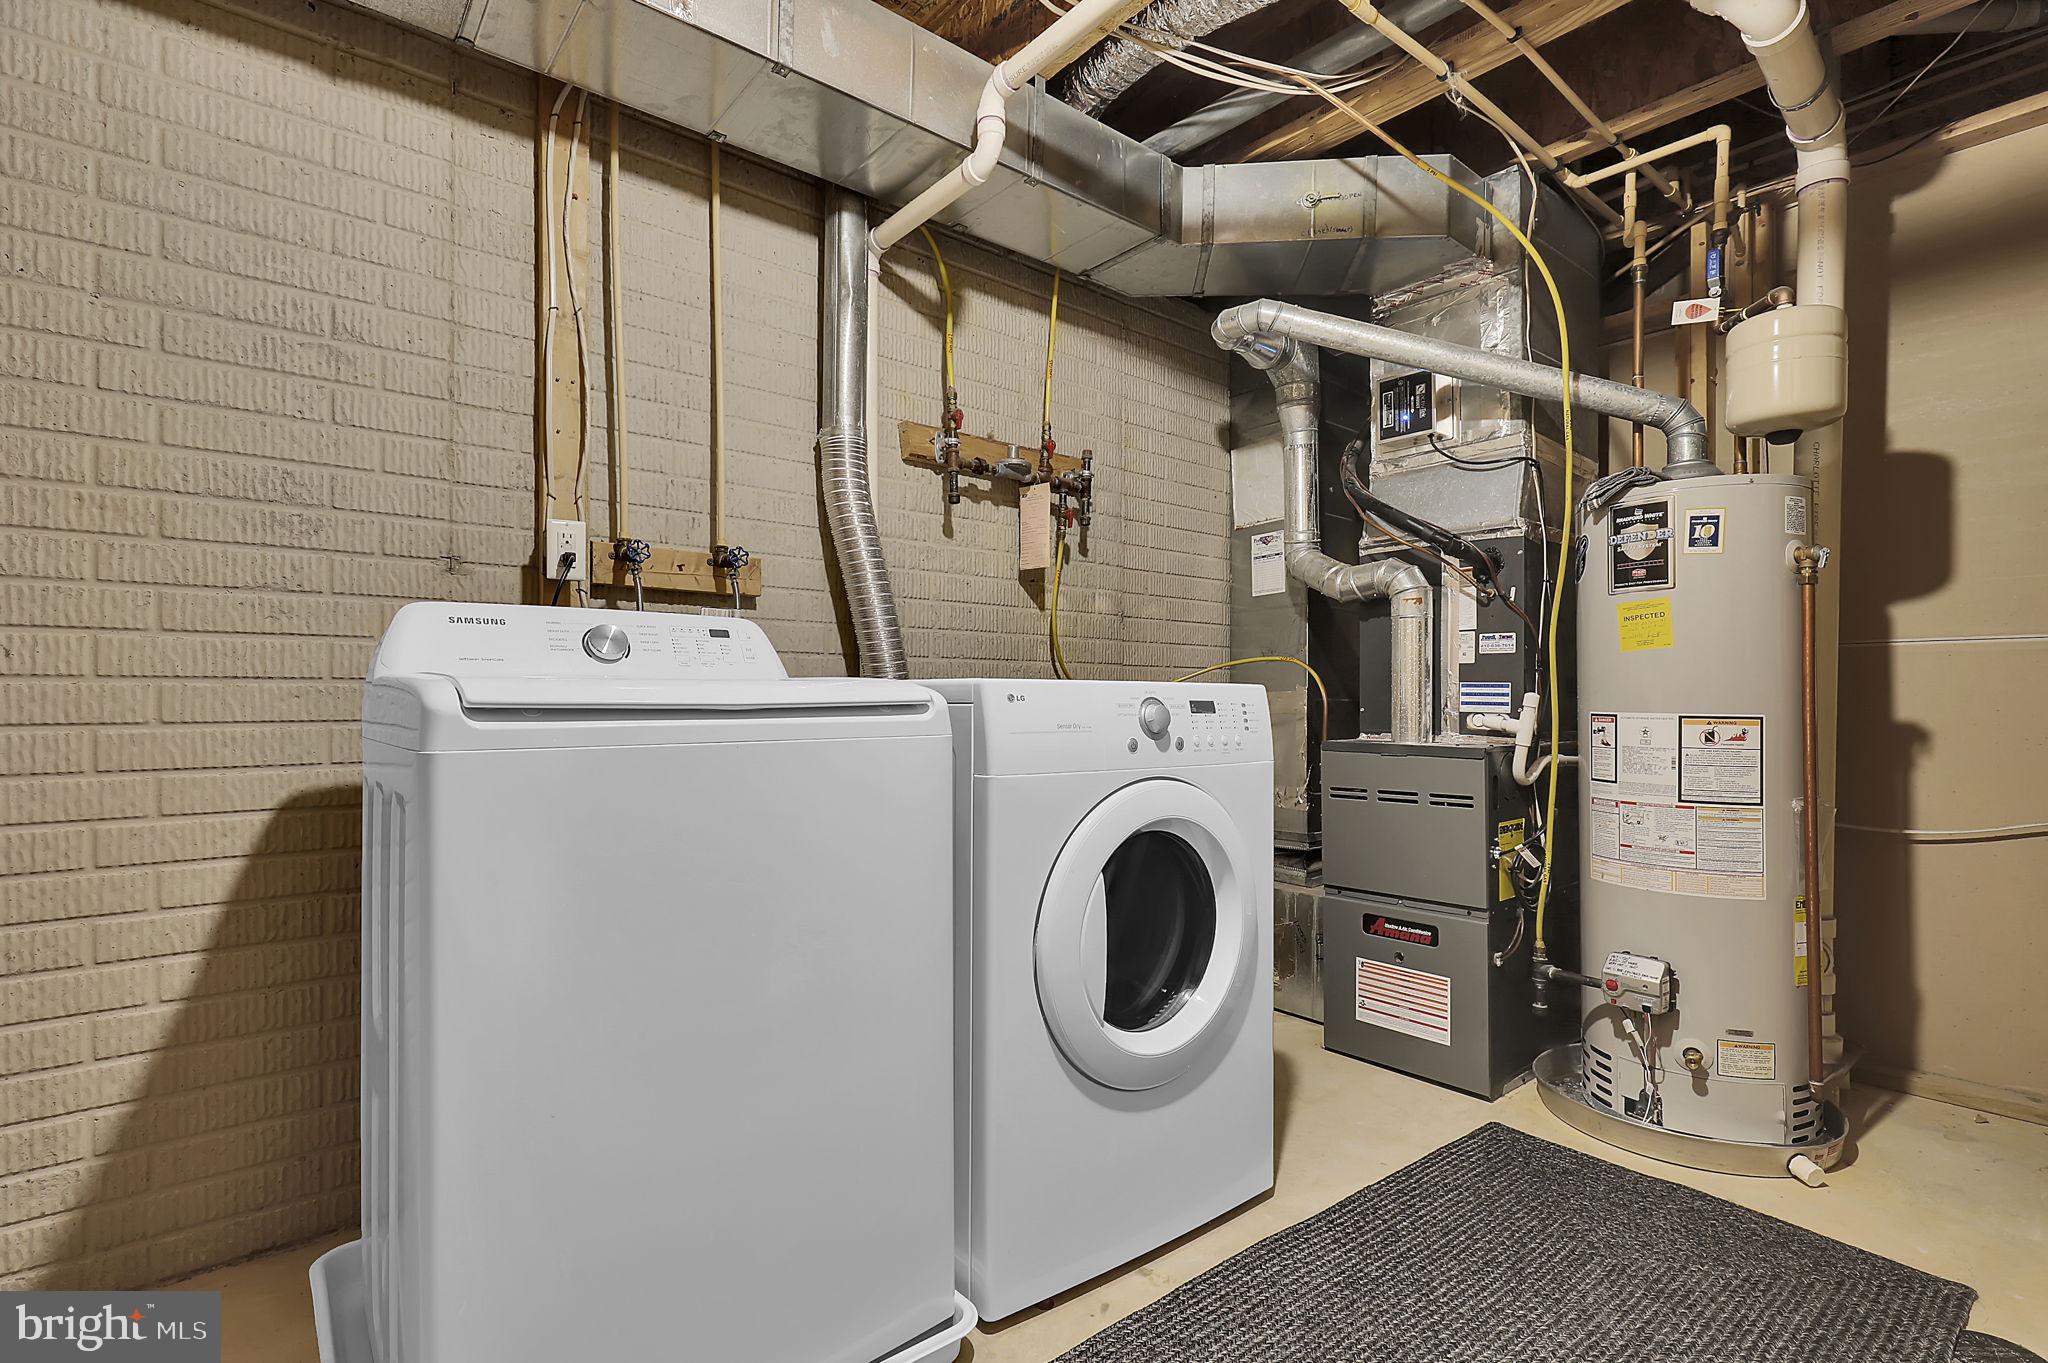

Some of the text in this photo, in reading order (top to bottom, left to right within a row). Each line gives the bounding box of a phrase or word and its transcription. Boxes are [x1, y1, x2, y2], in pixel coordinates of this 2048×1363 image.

[1812, 441, 1821, 497] CHARLOTTE
[1609, 528, 1674, 545] DEFENDER
[1691, 524, 1715, 538] 10
[448, 616, 506, 625] SAMSUNG
[1623, 611, 1666, 622] INSPECTED
[1072, 722, 1081, 731] Dry
[1369, 917, 1432, 945] Amana
